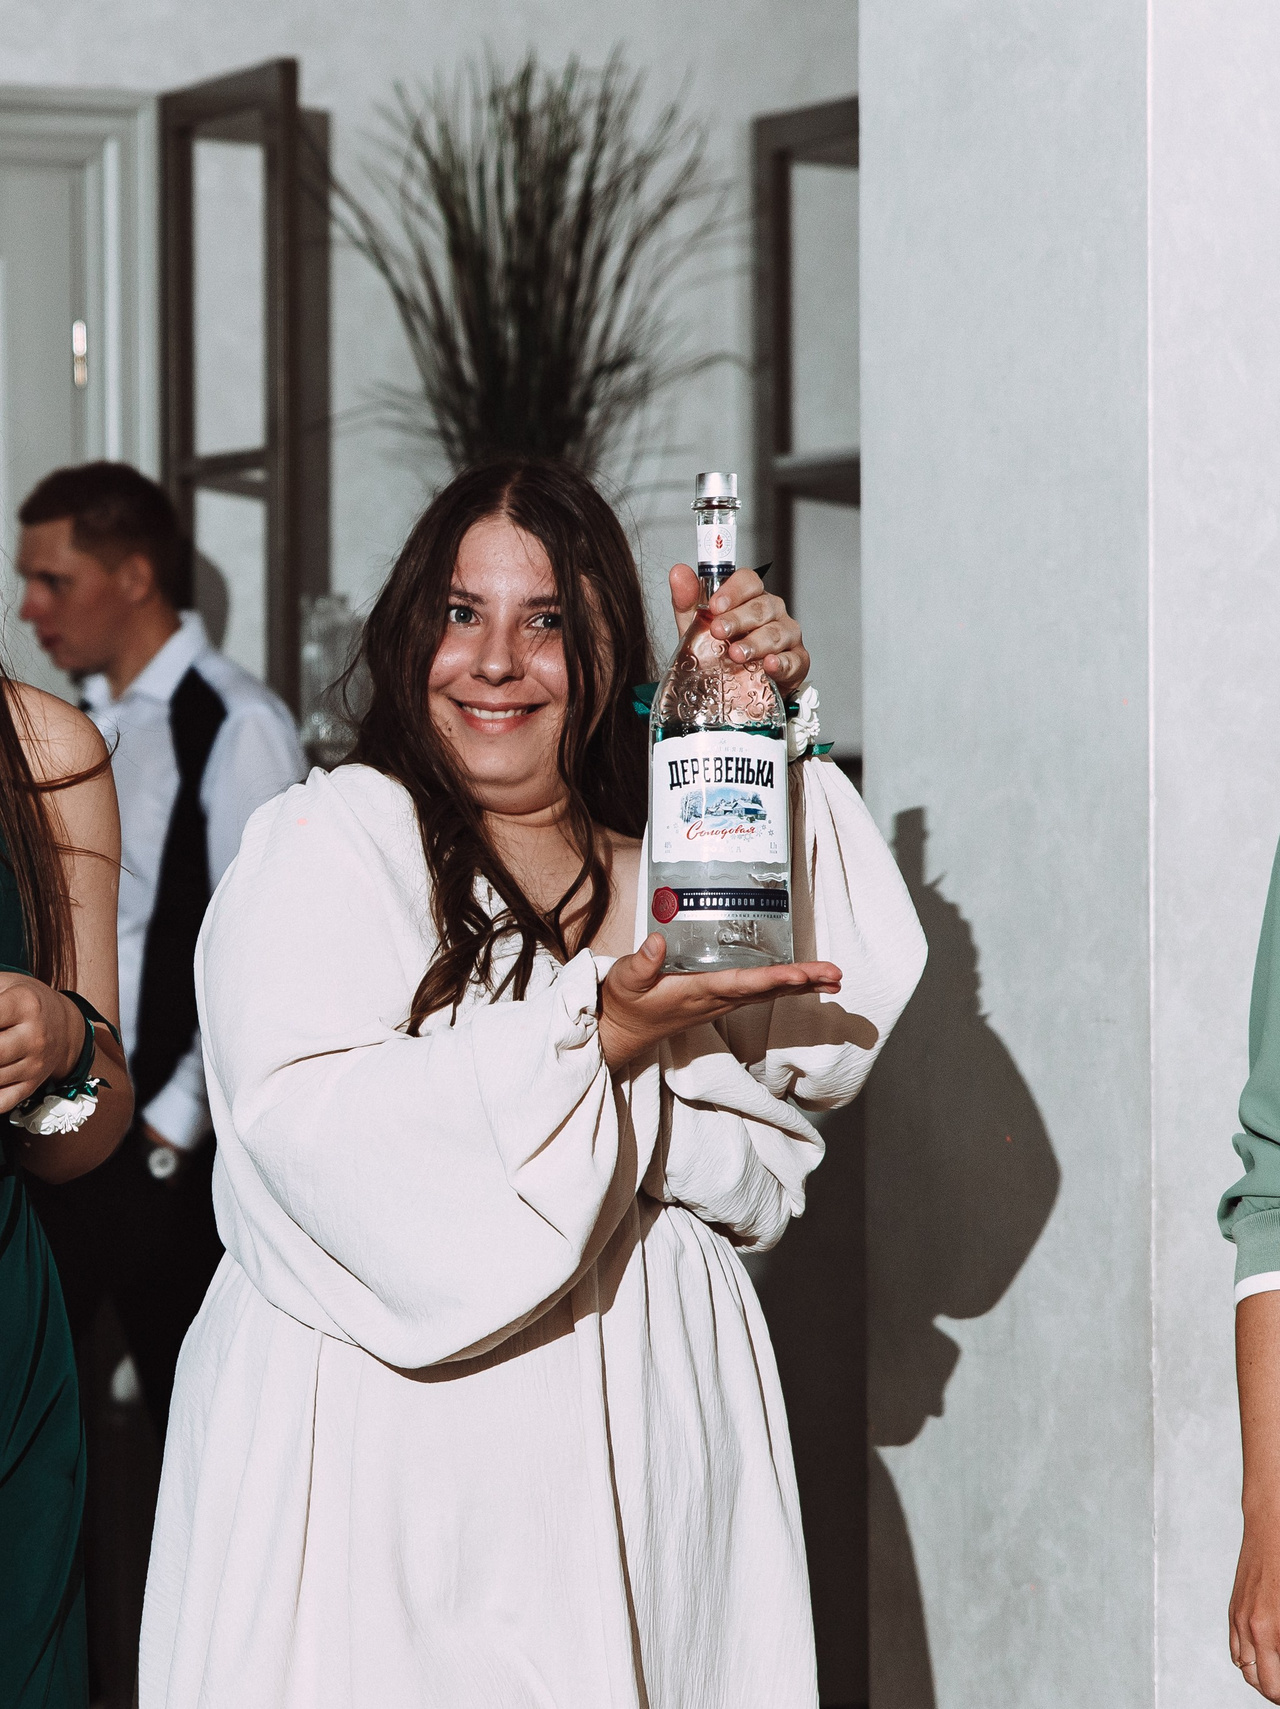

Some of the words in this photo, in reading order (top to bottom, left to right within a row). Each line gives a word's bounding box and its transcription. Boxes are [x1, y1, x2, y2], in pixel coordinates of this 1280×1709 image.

[668, 756, 775, 790] ДЕРЕВЕНЬКА
[686, 819, 756, 842] Солодовая
[699, 897, 756, 907] СОЛОДОВОМ
